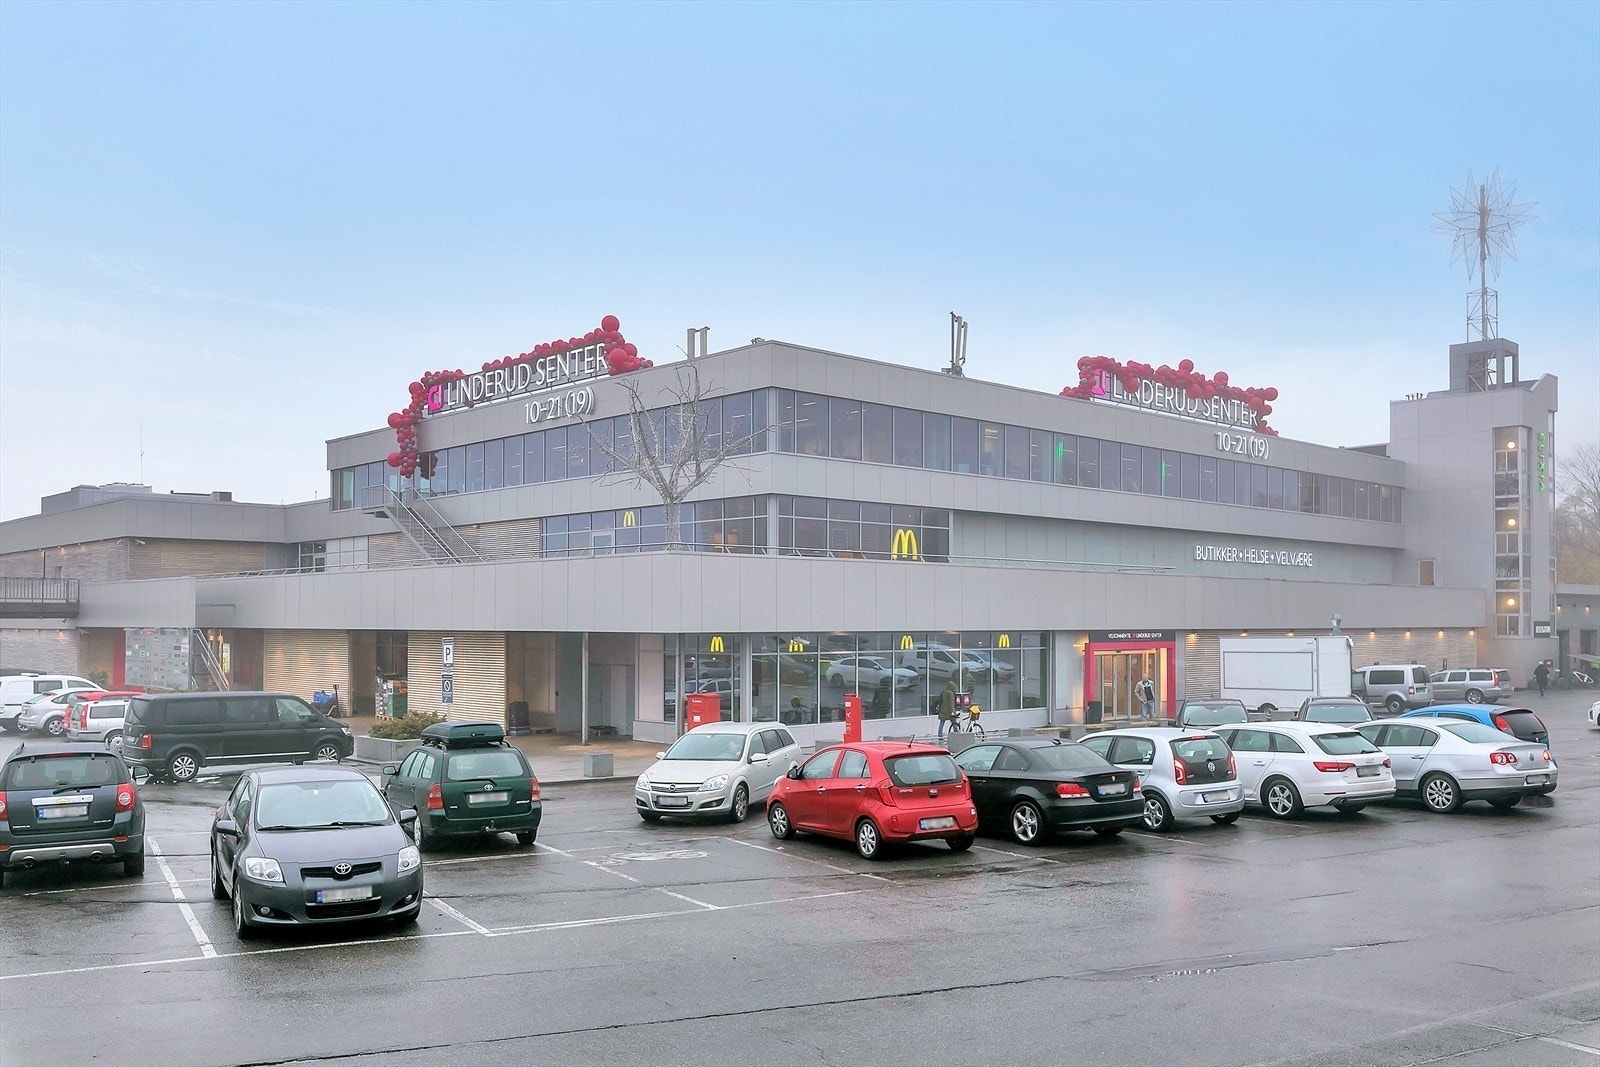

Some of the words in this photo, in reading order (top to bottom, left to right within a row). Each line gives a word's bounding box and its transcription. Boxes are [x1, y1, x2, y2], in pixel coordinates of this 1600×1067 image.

[447, 363, 530, 405] LINDERUD
[536, 342, 609, 385] SENTER
[524, 395, 560, 425] 10-21
[564, 386, 592, 417] (19)
[1203, 395, 1258, 426] SENTER
[1217, 432, 1248, 455] 10-21
[1250, 436, 1269, 460] (19)
[1196, 545, 1238, 562] BUTIKKER
[1244, 549, 1270, 564] HELSE
[1275, 551, 1313, 567] VELVÆRE
[445, 647, 450, 661] P
